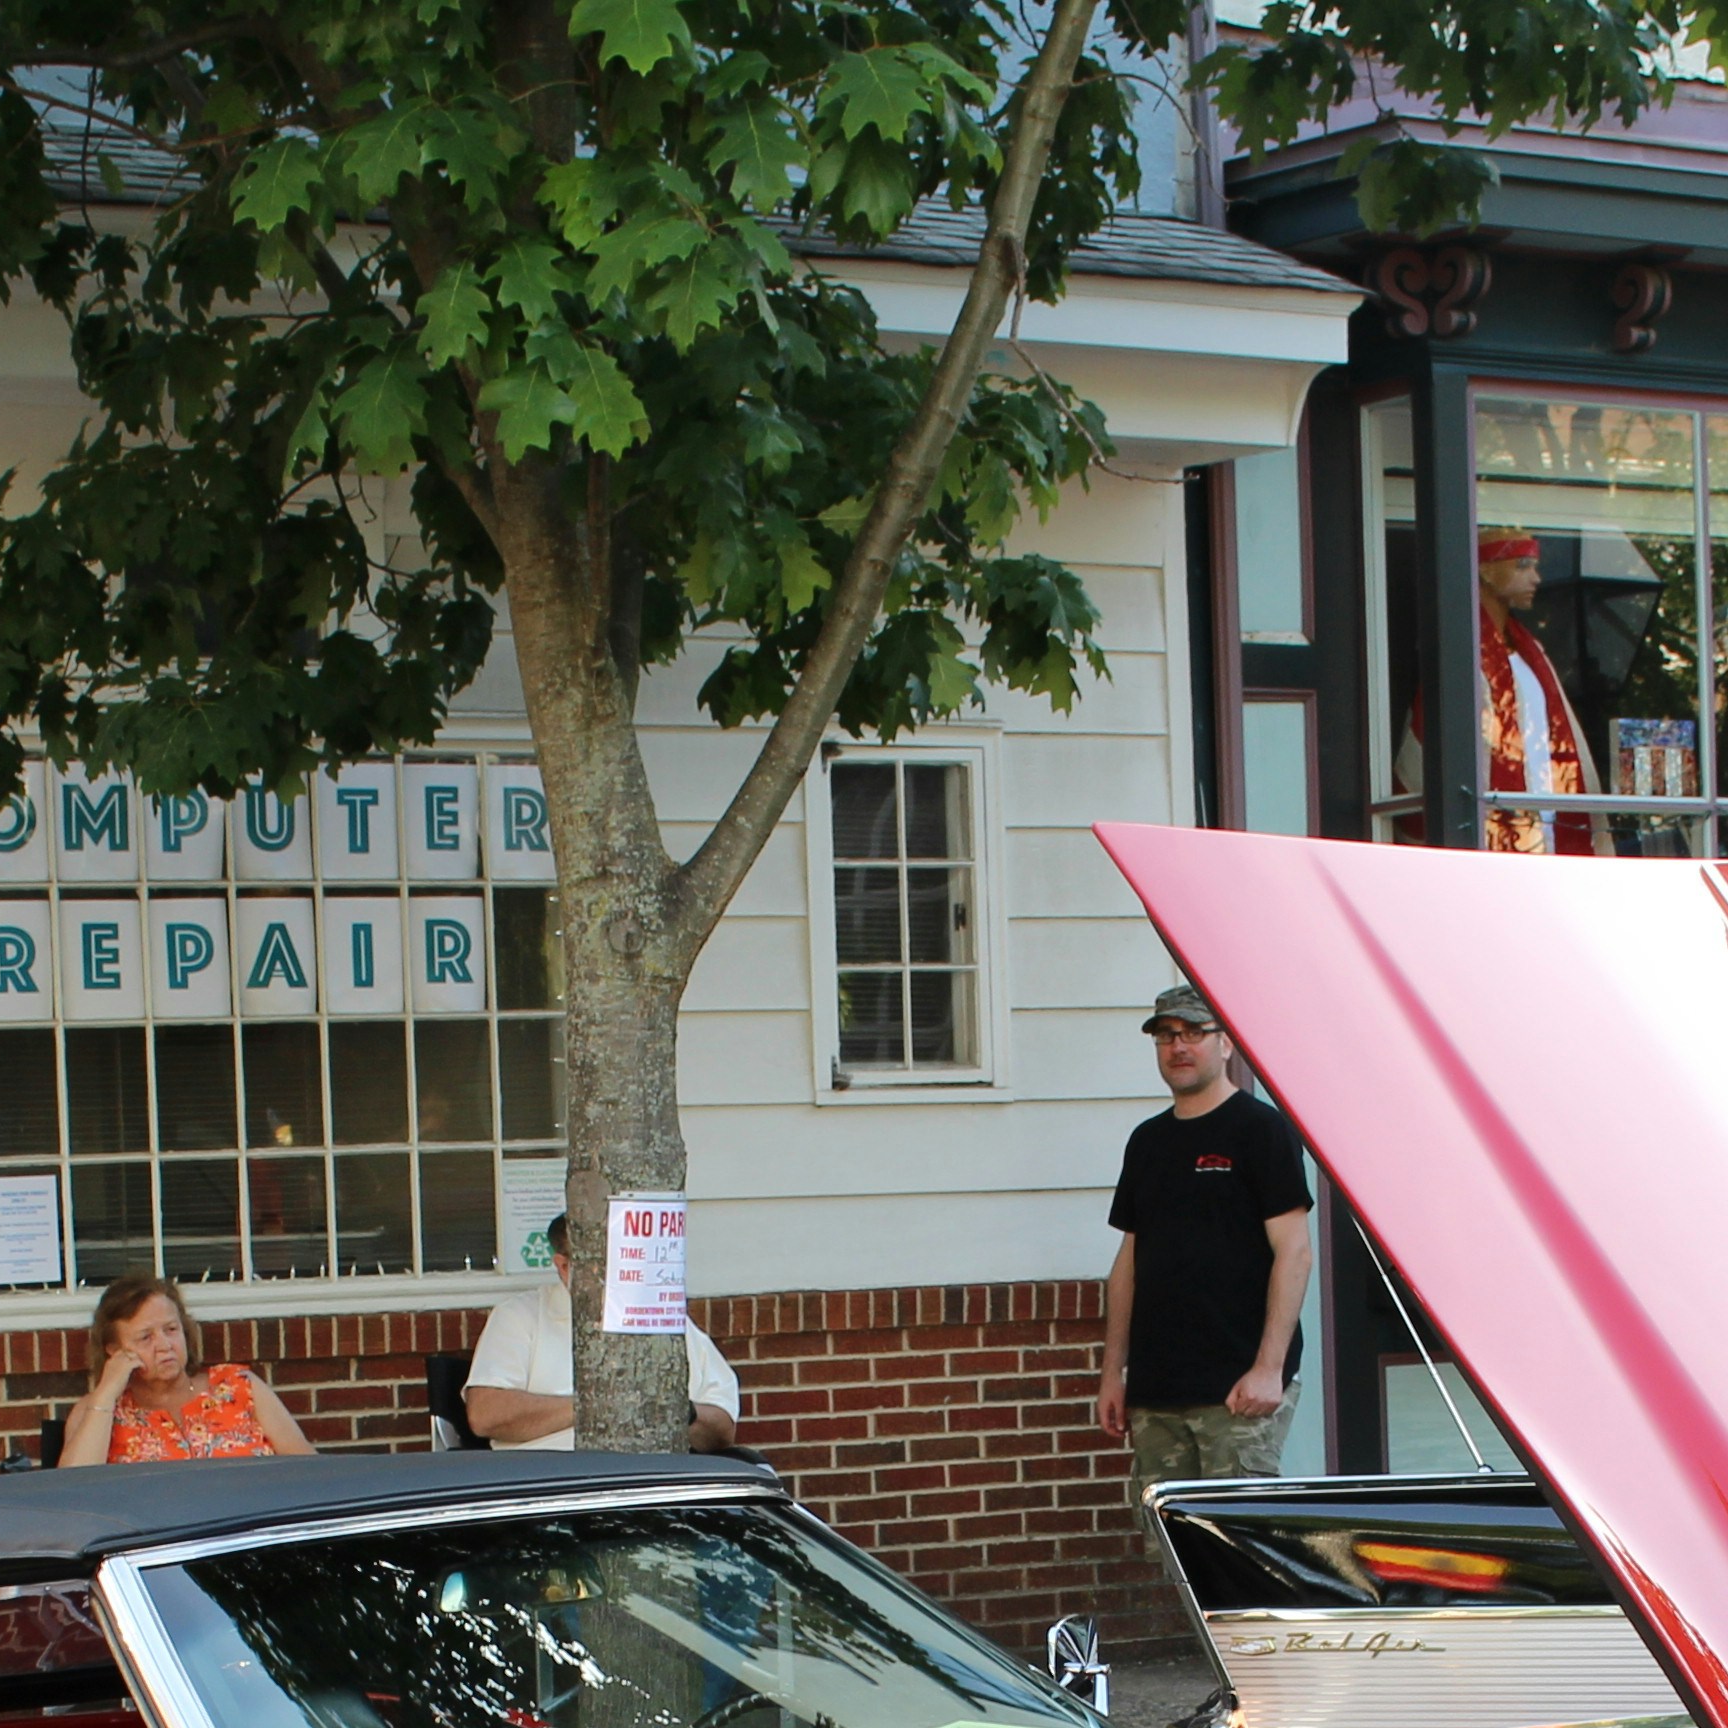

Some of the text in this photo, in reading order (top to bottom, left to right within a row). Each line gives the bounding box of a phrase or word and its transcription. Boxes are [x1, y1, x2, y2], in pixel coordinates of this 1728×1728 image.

[623, 1210, 654, 1238] NO
[619, 1246, 647, 1260] TIME:
[619, 1269, 644, 1282] DATE:
[1283, 1631, 1446, 1659] Bel Air
